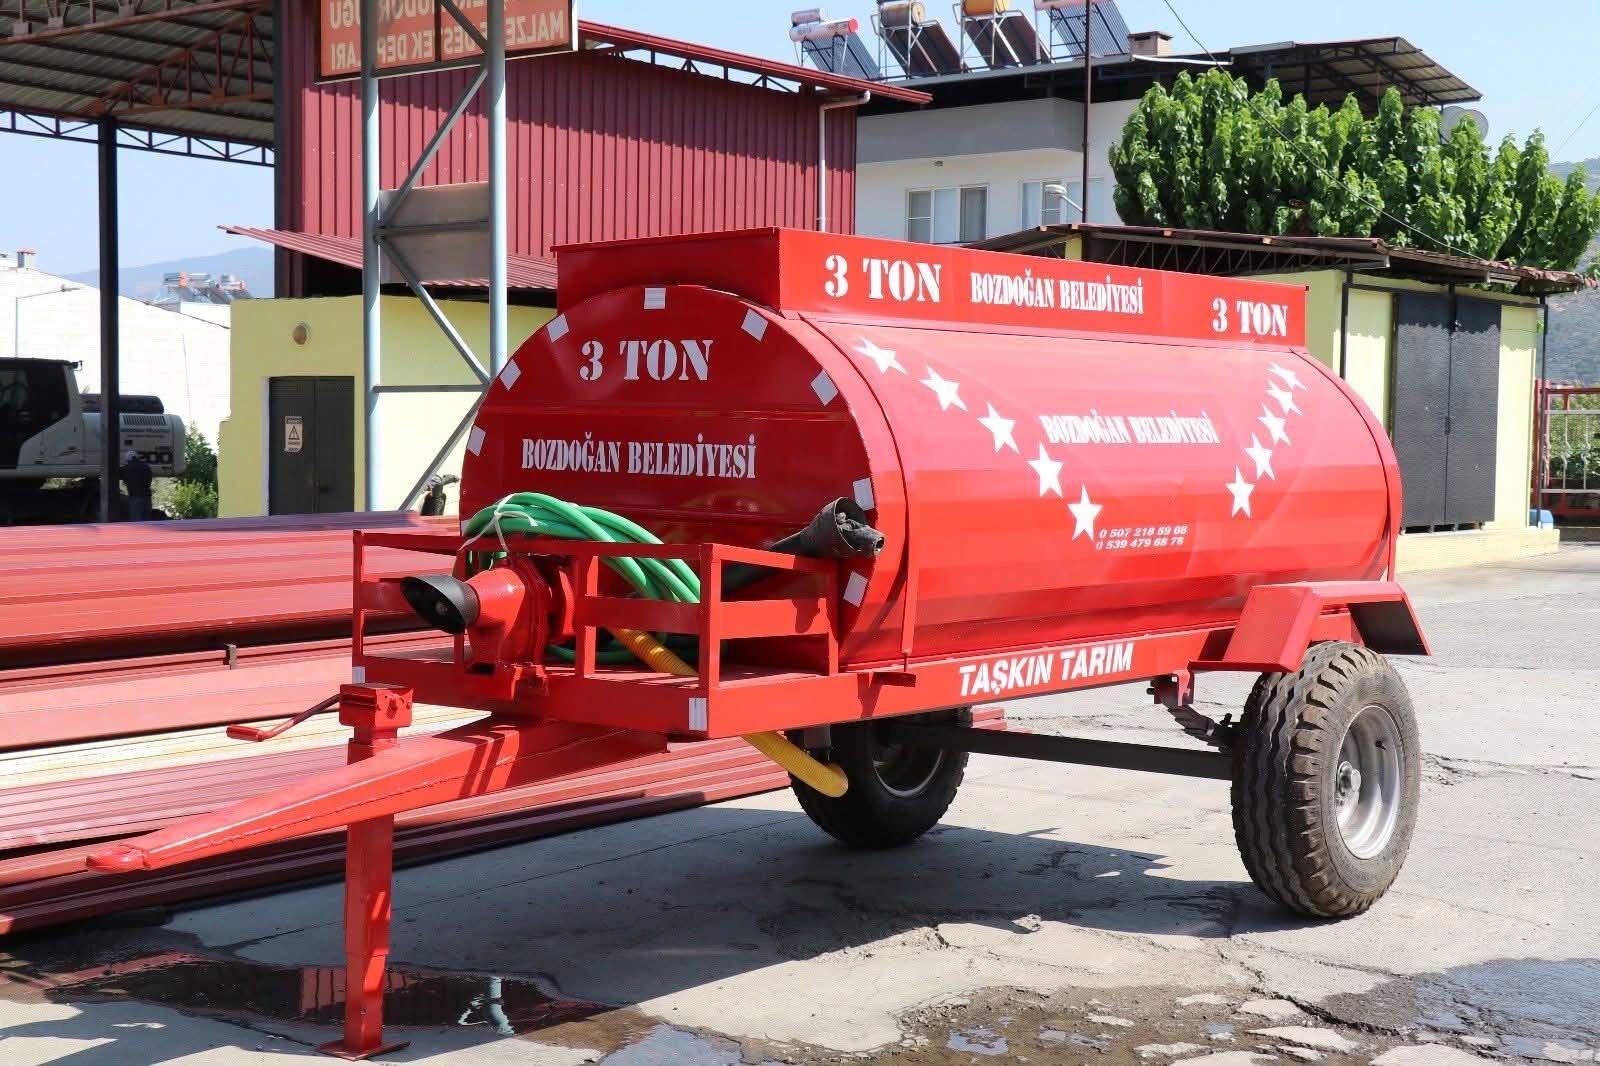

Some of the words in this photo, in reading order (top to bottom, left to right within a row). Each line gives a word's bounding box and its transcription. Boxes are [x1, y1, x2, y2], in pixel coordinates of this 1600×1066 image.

[824, 254, 849, 298] 3
[862, 257, 942, 303] TON
[970, 268, 1055, 309] BOZDOĞAN
[1059, 274, 1144, 315] BELEDİYESİ
[1212, 297, 1228, 333] 3
[1236, 300, 1289, 337] TON
[579, 340, 604, 381] 3
[619, 339, 714, 381] TON
[1039, 408, 1132, 444] BOZDOĞAN
[1127, 409, 1221, 444] BELEDİYESİ
[521, 431, 622, 473] BOZDOĞAN
[627, 433, 757, 479] BELEDİYESİ
[1095, 540, 1104, 550] 0
[1106, 540, 1128, 550] 539
[1130, 538, 1152, 548] 479
[1099, 529, 1108, 539] 0
[1109, 528, 1132, 538] 507
[1133, 527, 1155, 537] 218
[959, 654, 1054, 697] TAŞKIN
[1060, 642, 1134, 681] TARIM
